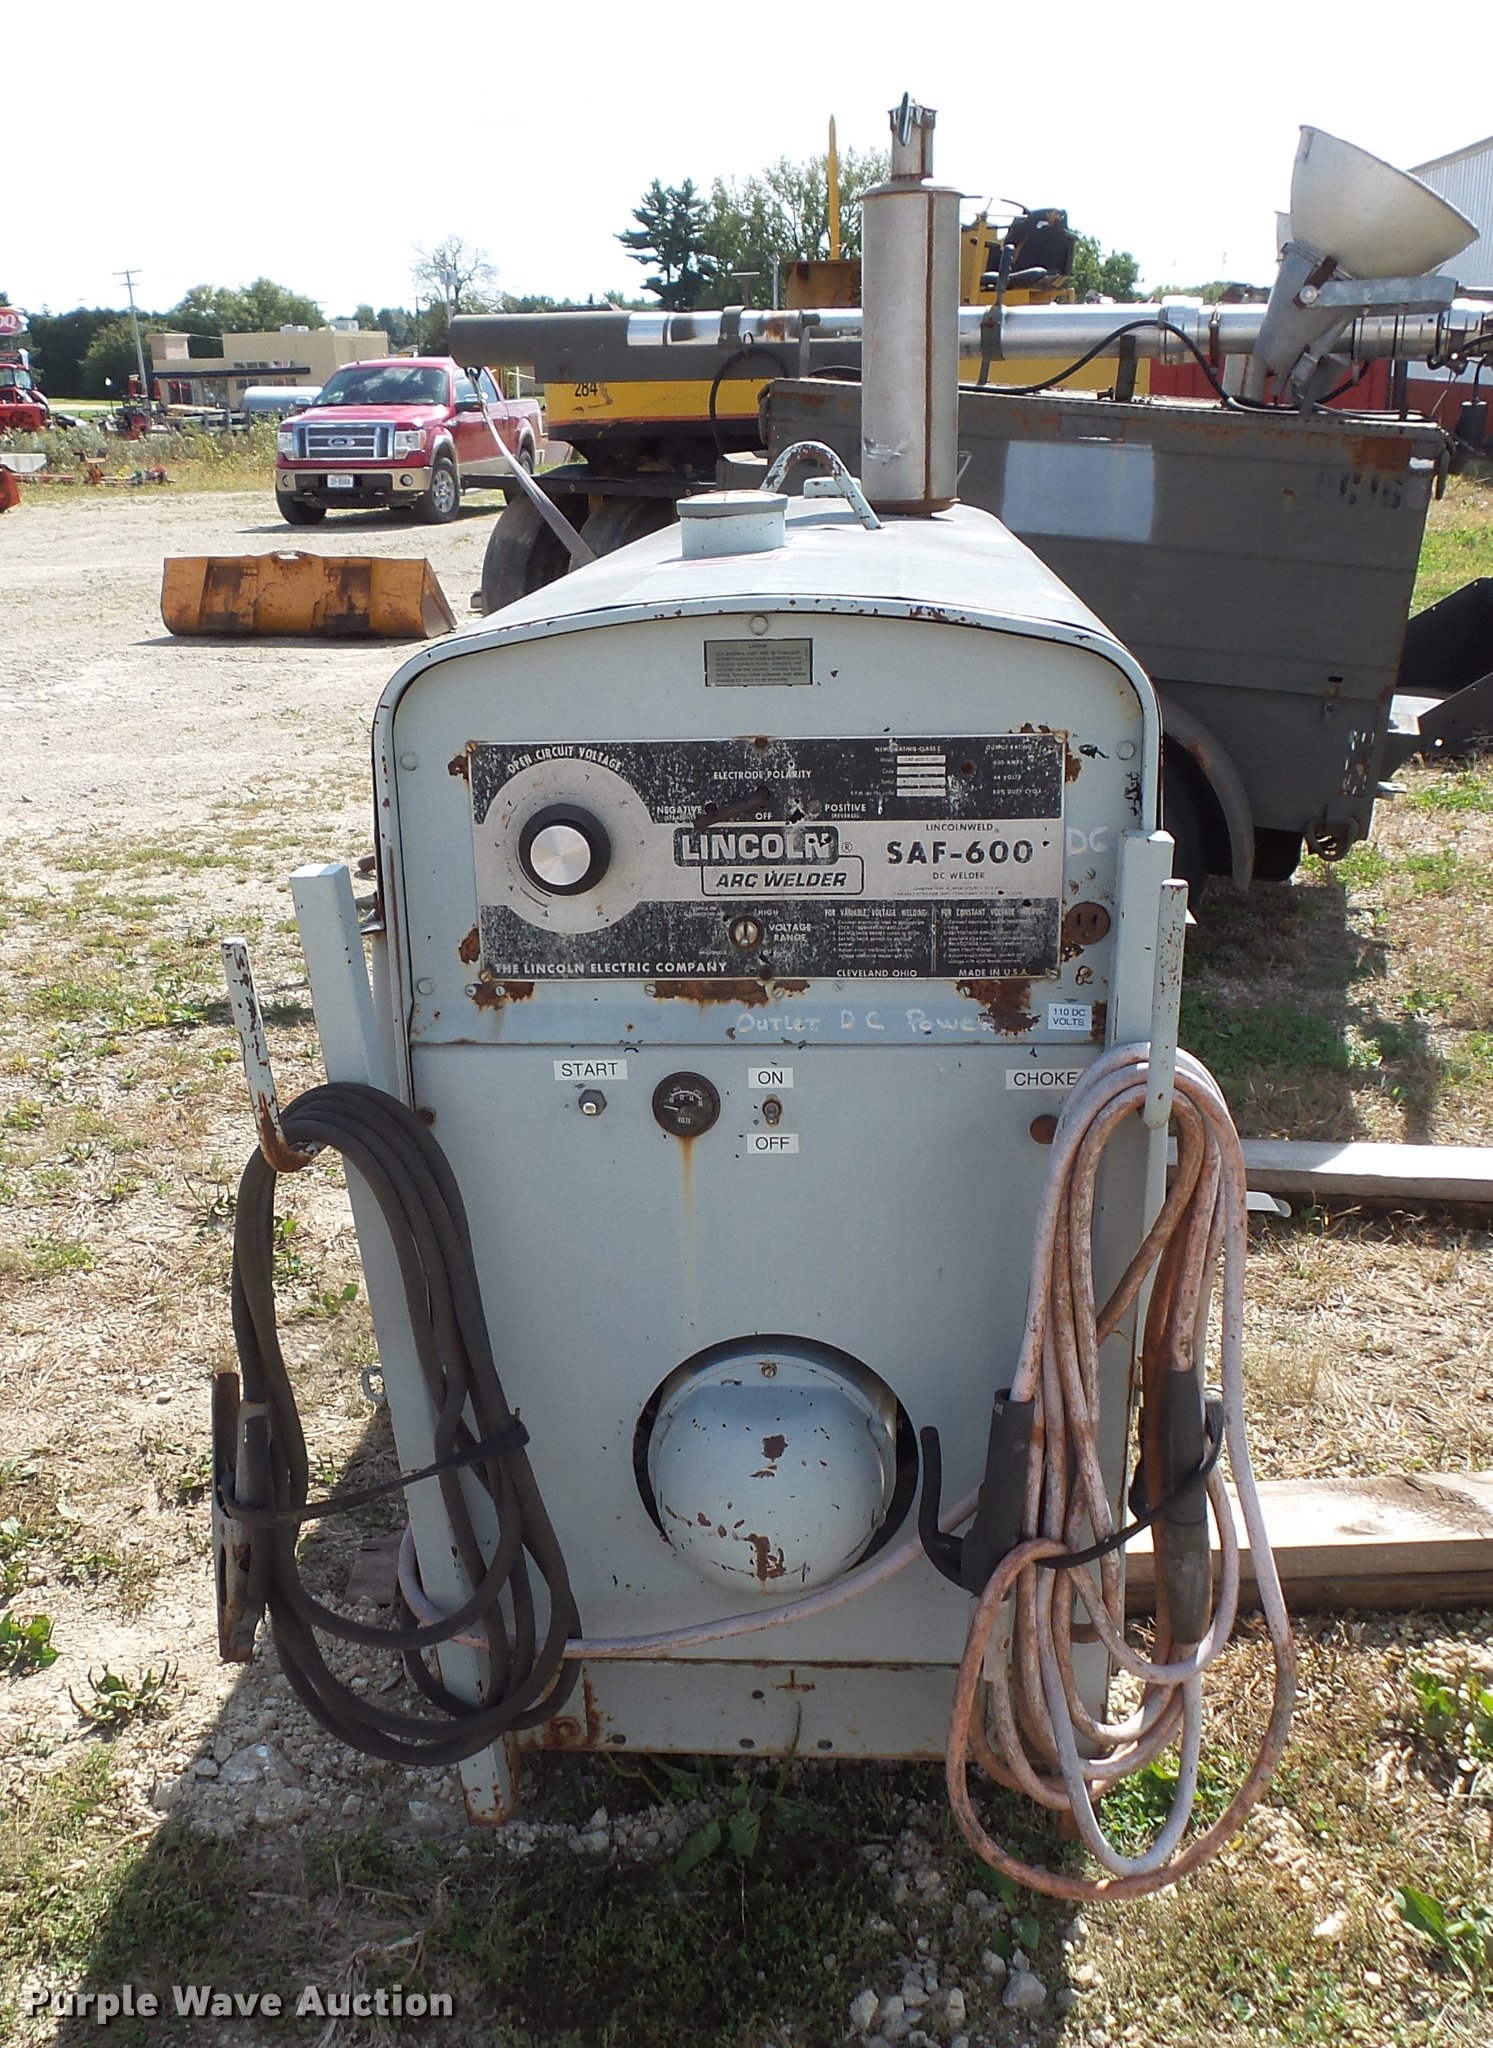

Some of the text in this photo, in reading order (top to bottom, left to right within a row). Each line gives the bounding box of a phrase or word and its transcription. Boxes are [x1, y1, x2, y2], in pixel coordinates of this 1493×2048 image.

[507, 746, 622, 774] OPEN CIRCUIT VOLTAGE
[714, 770, 812, 780] ELECTRODE POLARITY
[656, 805, 702, 815] NEGATIVE
[825, 803, 867, 813] POSITIVE
[755, 811, 773, 821] OFF
[925, 823, 994, 832] LINCOLNWELD
[1066, 826, 1108, 856] DC
[681, 833, 831, 860] LINCOLN
[887, 840, 1034, 865] SAF-600
[716, 871, 847, 888] ARC WELDER
[933, 871, 985, 880] DC WELDER
[769, 923, 812, 932] VOLTAGE
[773, 934, 806, 942] RANGE
[495, 962, 727, 974] THE LINCOLN ELECTRIC COMPANY
[837, 969, 918, 977] CLEVELAND OHIO
[958, 968, 987, 977] MADE
[989, 968, 1000, 976] IN
[1053, 1008, 1086, 1017] 110 DC
[1053, 1018, 1085, 1026] VOLTS
[561, 1062, 619, 1077] START
[757, 1071, 784, 1085] ON
[1013, 1072, 1078, 1086] CHOKE
[755, 1136, 790, 1151] OFF
